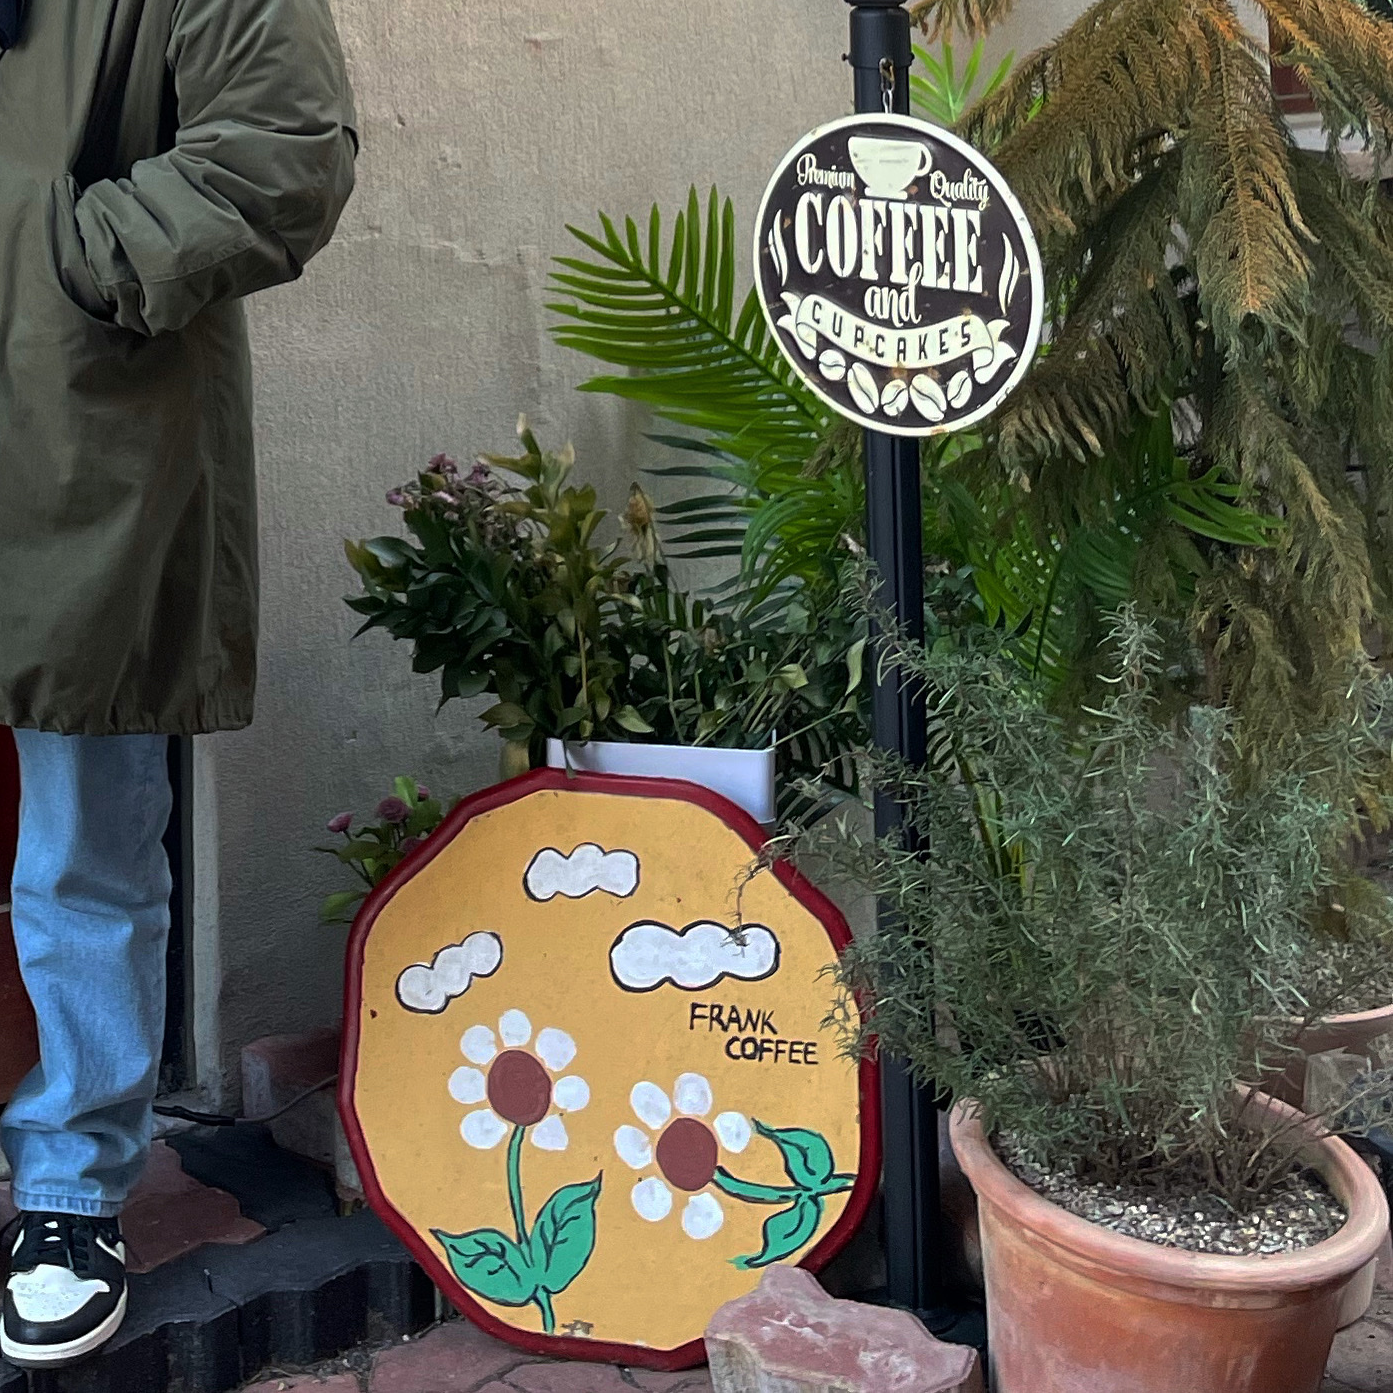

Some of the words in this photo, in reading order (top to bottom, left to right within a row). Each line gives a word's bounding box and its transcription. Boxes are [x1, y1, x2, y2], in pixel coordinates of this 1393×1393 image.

[796, 153, 855, 189] Premium
[929, 168, 990, 210] Quality
[794, 191, 984, 294] COFFEE
[864, 261, 922, 327] and
[812, 300, 972, 362] CUPCAKES
[689, 1002, 778, 1035] FRANK
[725, 1035, 819, 1065] COFFEE
